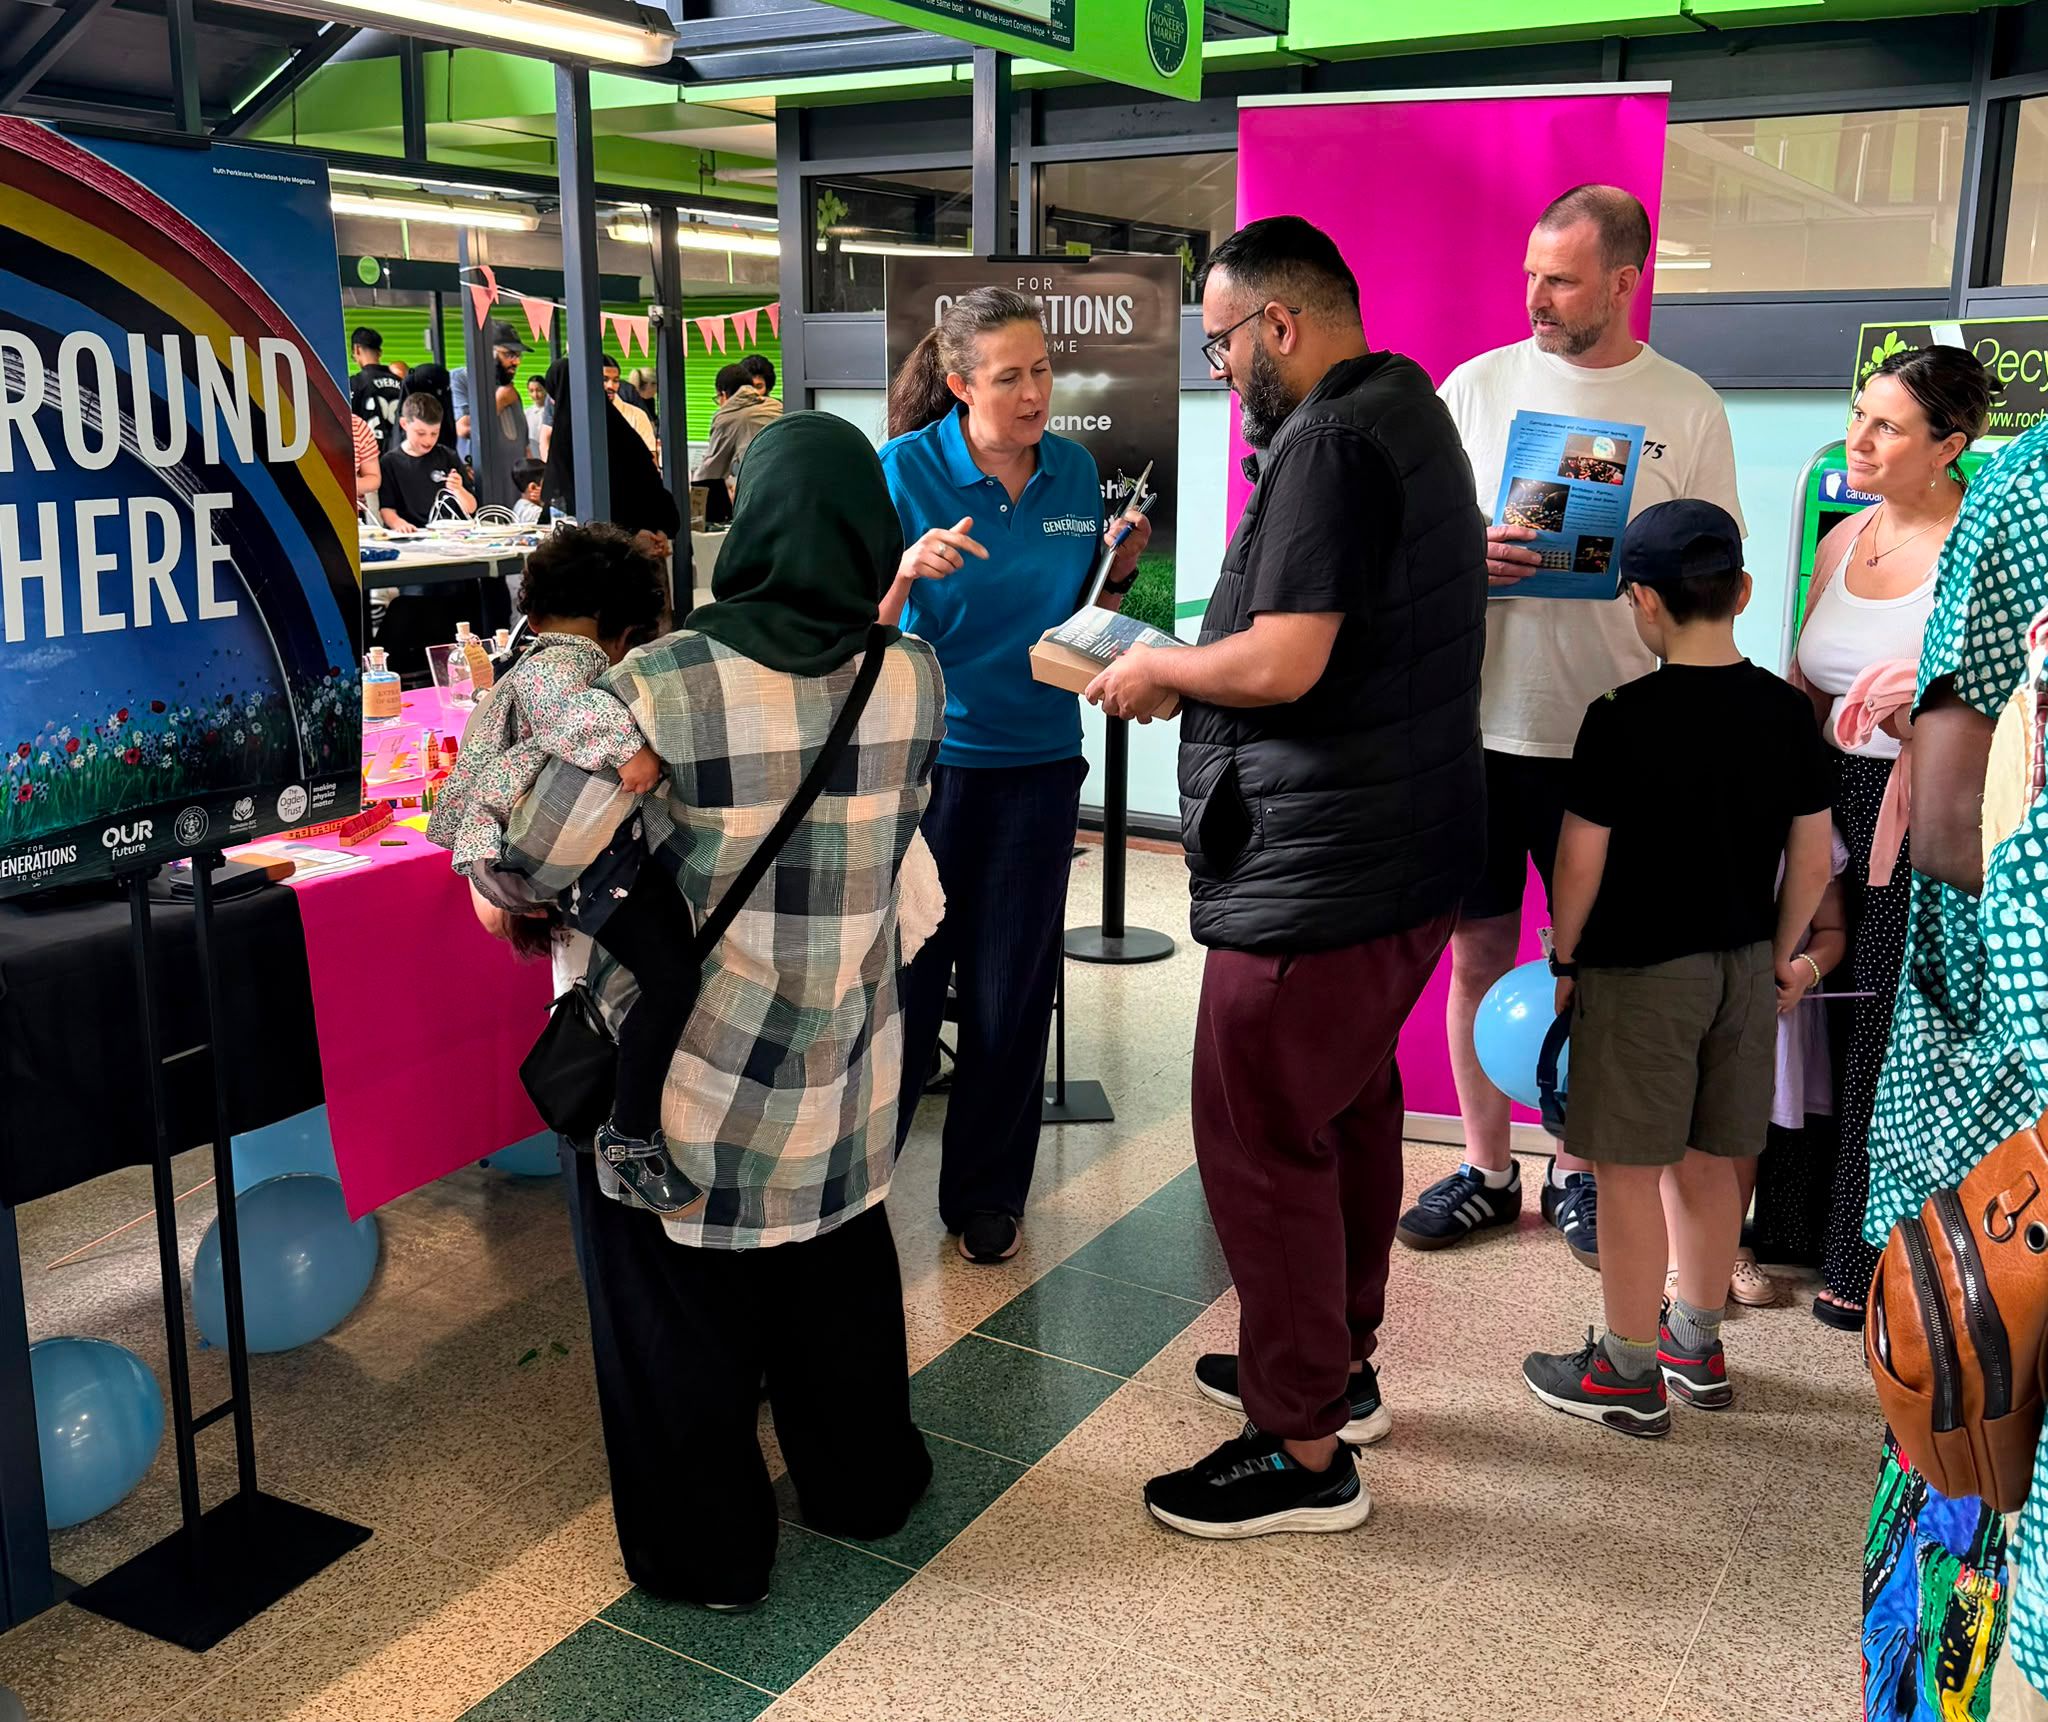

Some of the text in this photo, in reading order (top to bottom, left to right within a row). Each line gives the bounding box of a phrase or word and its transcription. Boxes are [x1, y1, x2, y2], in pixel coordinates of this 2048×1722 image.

[951, 2, 964, 13] boat
[982, 11, 998, 23] Whole
[998, 15, 1013, 28] Heart
[1013, 19, 1032, 33] Cometh
[1032, 25, 1045, 37] Hope
[1052, 31, 1071, 44] Success
[1151, 12, 1185, 34] PIONEERS
[1153, 24, 1181, 44] MARKET
[1017, 277, 1053, 291] FOR
[0, 329, 313, 473] ROUND
[2, 492, 239, 643] HERE
[312, 782, 337, 793] making
[280, 794, 305, 808] Ogden
[312, 791, 336, 802] physics
[312, 799, 335, 809] matter
[284, 806, 302, 817] Trust
[102, 819, 153, 848] OUR
[27, 844, 44, 853] FOR
[111, 842, 147, 861] future
[0, 845, 77, 878] ENERATIONS
[16, 868, 54, 882] TO COME
